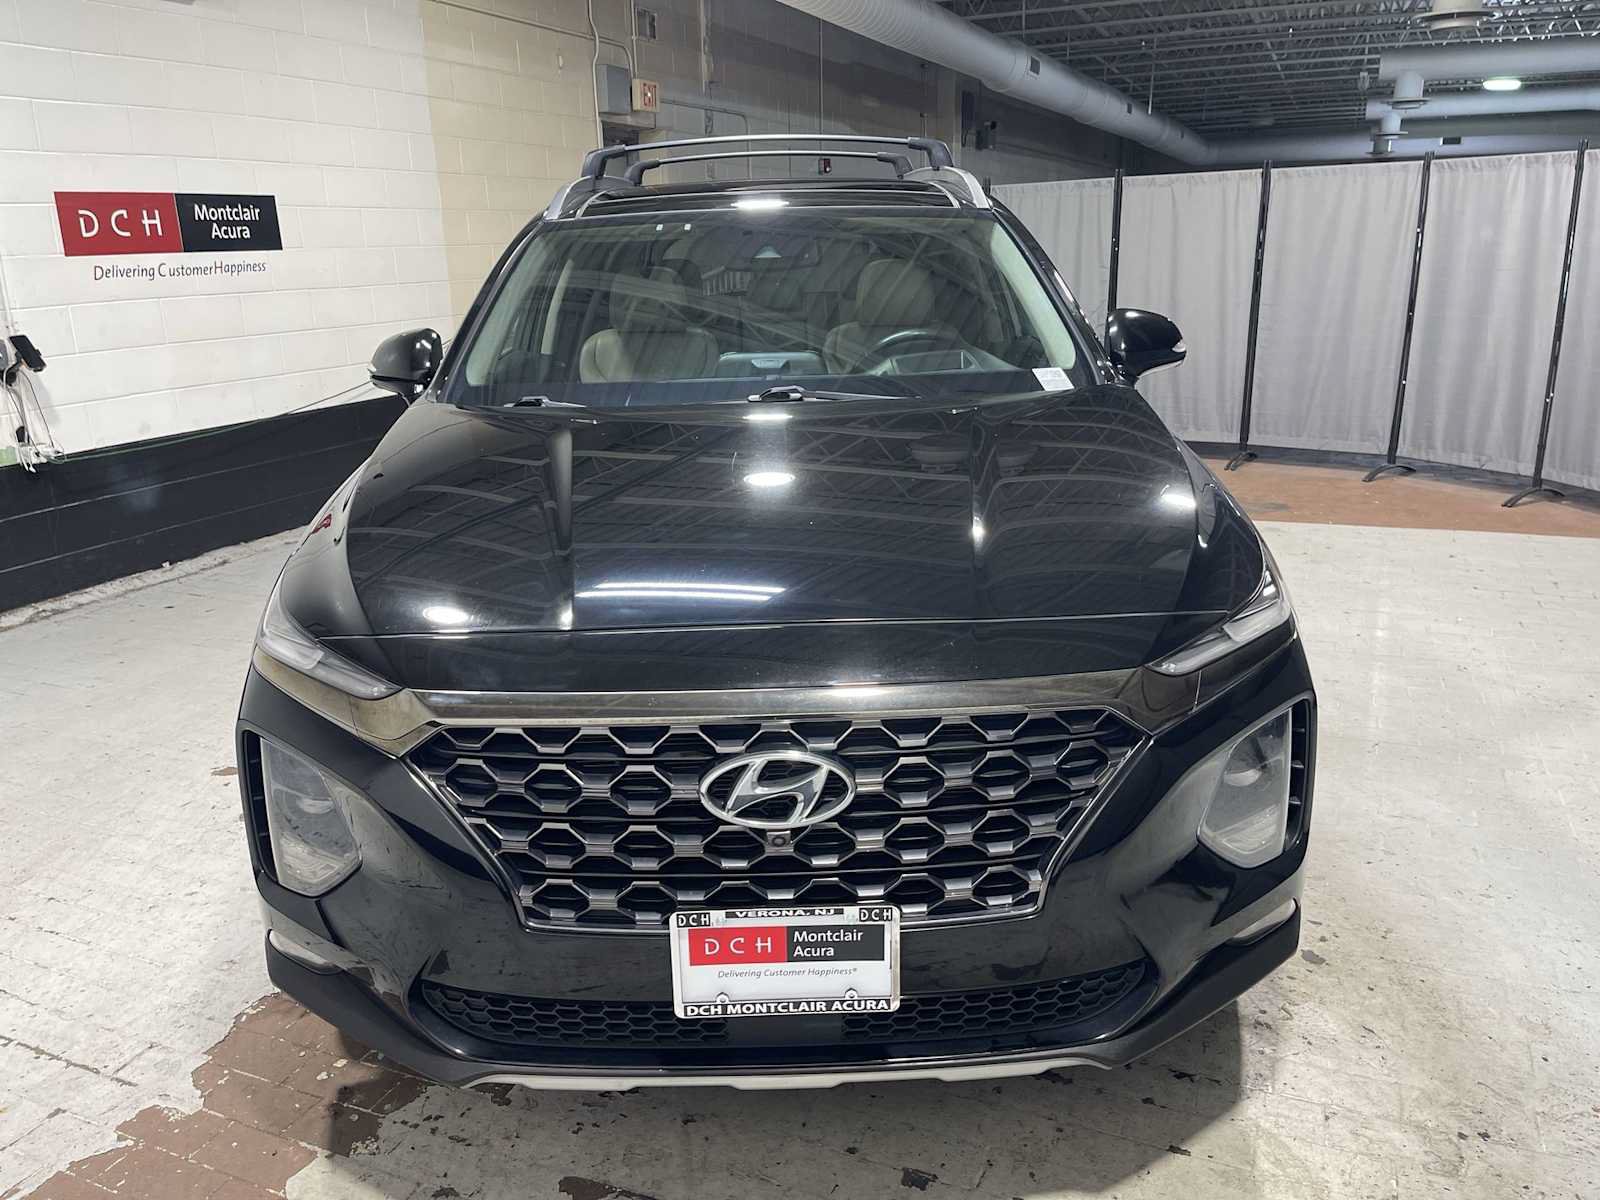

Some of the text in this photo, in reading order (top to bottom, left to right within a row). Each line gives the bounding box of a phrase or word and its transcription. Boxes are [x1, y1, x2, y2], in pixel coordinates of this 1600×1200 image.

[194, 204, 260, 221] Montclair
[78, 209, 162, 238] DCH
[211, 223, 251, 239] Acura
[94, 264, 155, 281] Delivering
[214, 260, 267, 275] Happiness
[678, 914, 710, 927] DCH
[859, 909, 893, 921] DCH
[793, 930, 863, 942] Montclair
[704, 937, 772, 955] DCH
[793, 946, 834, 957] Acura
[717, 969, 761, 978] Delivering
[764, 968, 805, 977] Customer
[686, 1000, 889, 1016] DCH MONTCLAIR ACURA
